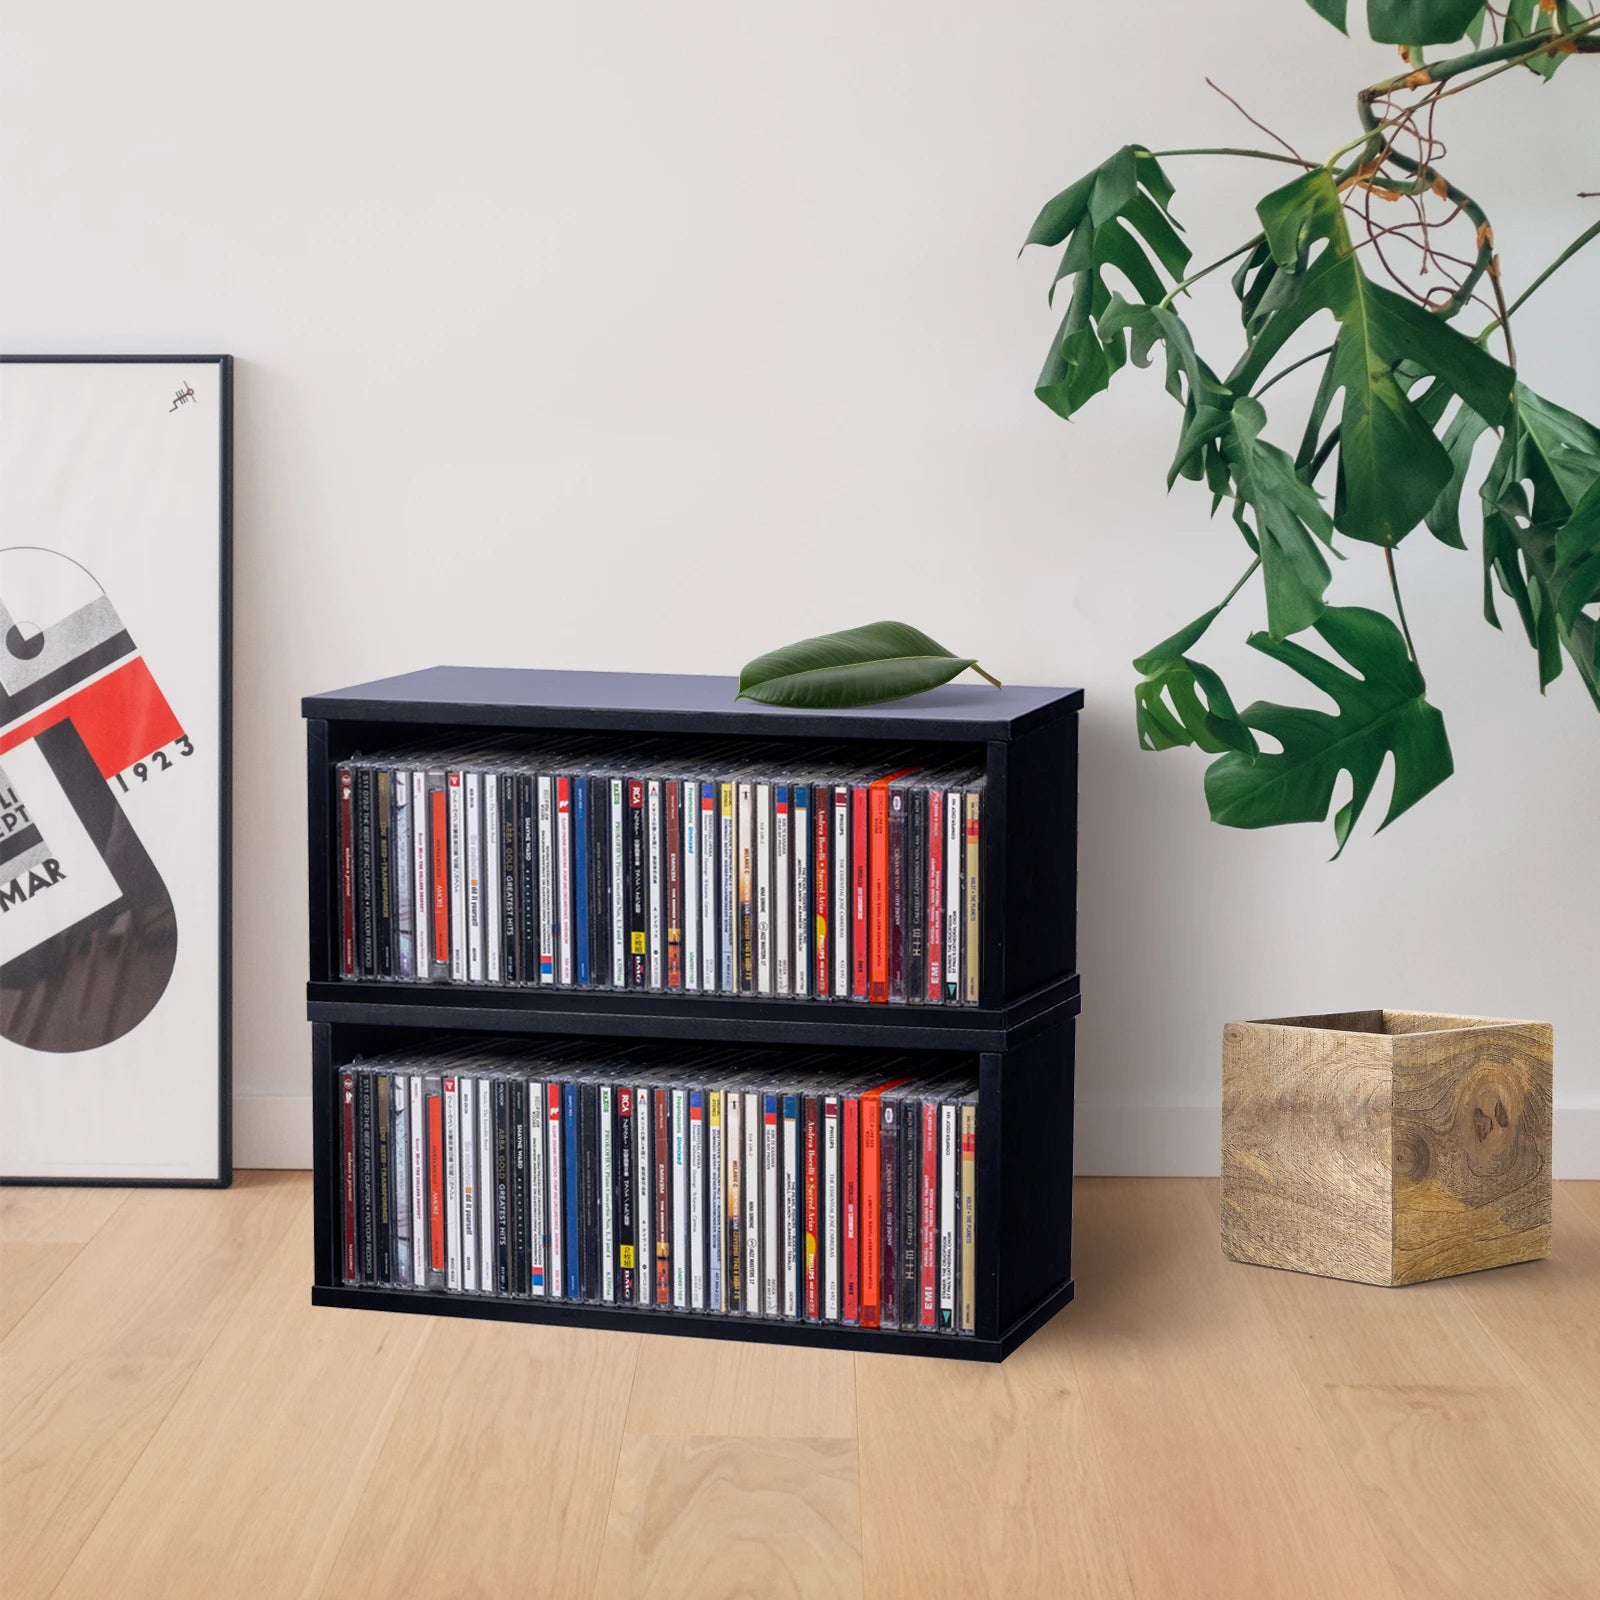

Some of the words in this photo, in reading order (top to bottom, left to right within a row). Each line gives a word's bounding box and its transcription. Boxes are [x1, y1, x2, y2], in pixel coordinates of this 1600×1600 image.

[115, 734, 194, 793] 1923
[632, 787, 641, 804] RCA
[818, 809, 826, 834] Andrea
[818, 837, 826, 860] Bocelli
[0, 858, 67, 913] MAR
[818, 869, 826, 893] Sacred
[471, 902, 479, 926] yourself
[931, 962, 939, 984] EMI
[621, 1094, 629, 1112] RCA
[808, 1184, 816, 1209] Sacred
[465, 1210, 473, 1235] yourself
[808, 1211, 816, 1231] Arias
[924, 1287, 933, 1309] EMI
